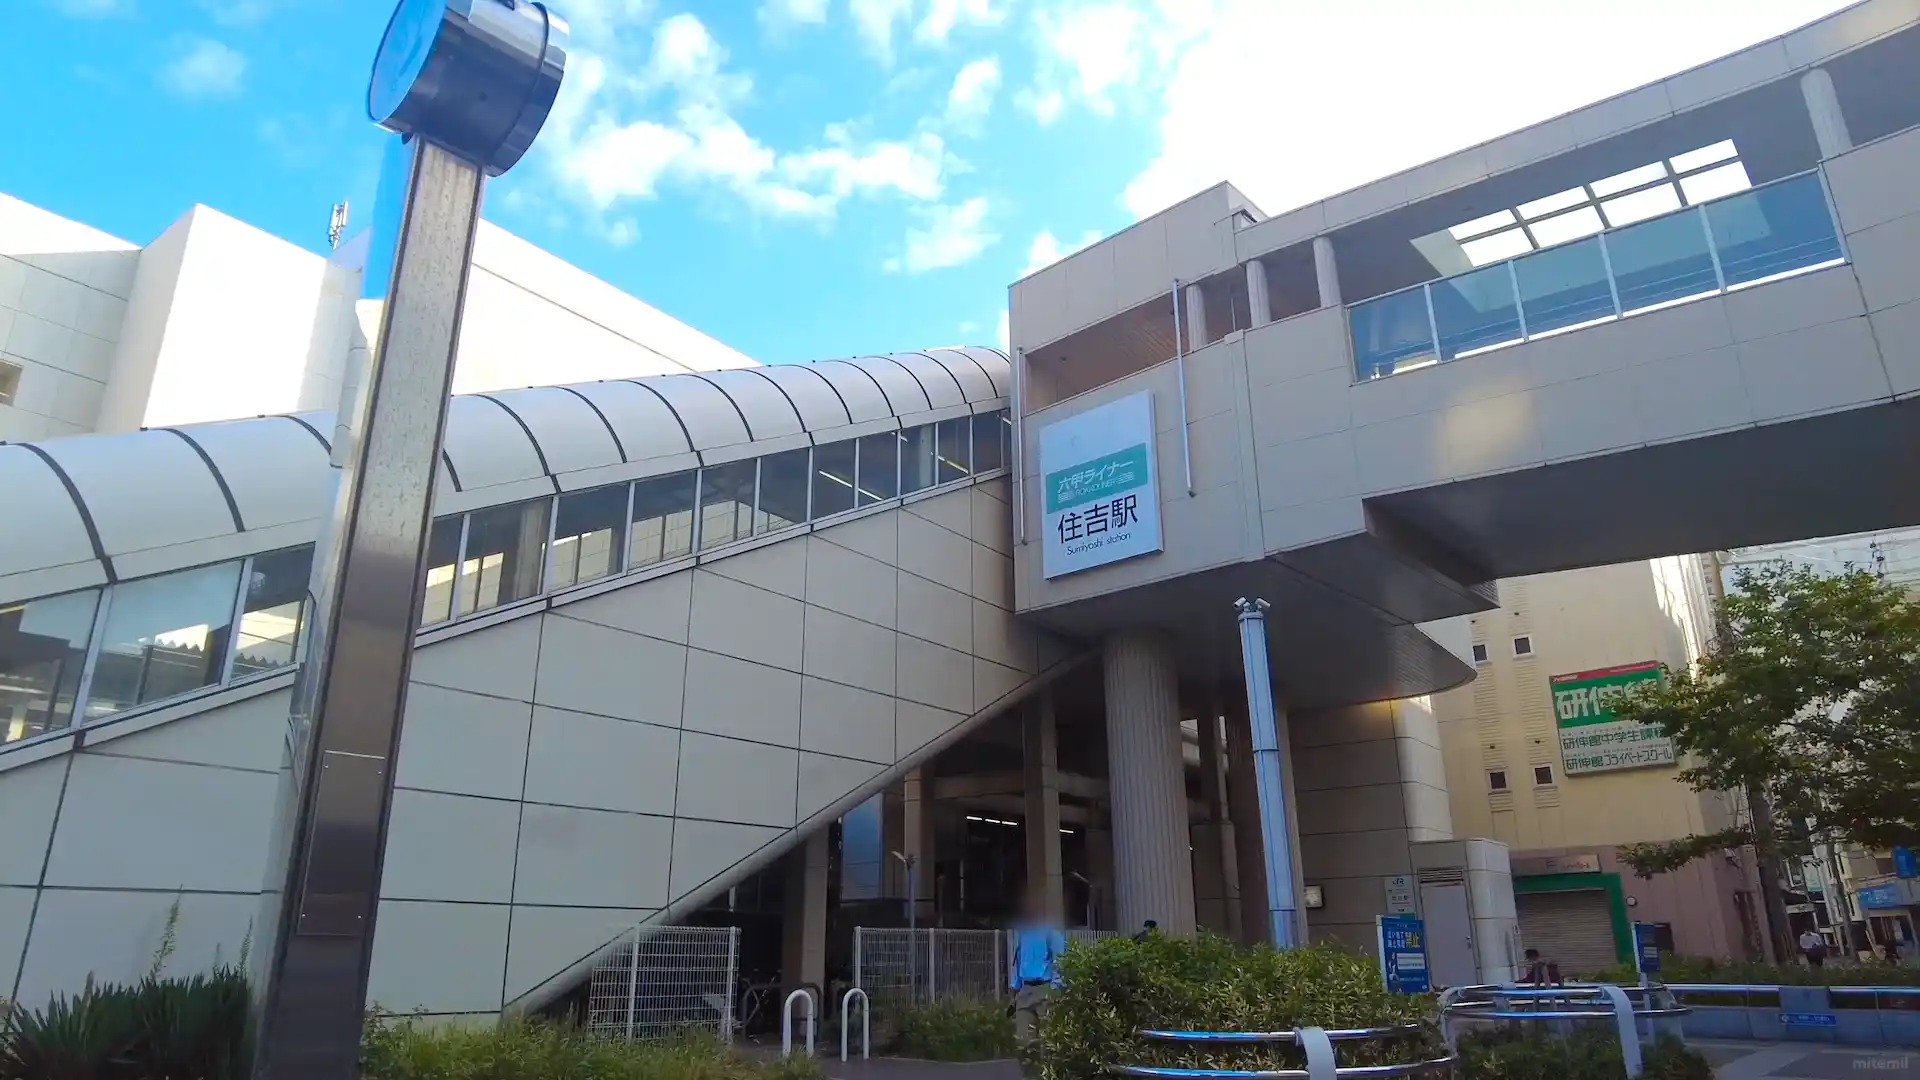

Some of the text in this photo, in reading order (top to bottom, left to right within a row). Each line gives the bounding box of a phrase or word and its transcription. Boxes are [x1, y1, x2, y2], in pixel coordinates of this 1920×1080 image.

[1058, 461, 1134, 493] 六甲ライナー
[1058, 494, 1138, 544] 住吉駅
[1067, 532, 1131, 555] Sumiyoshi station
